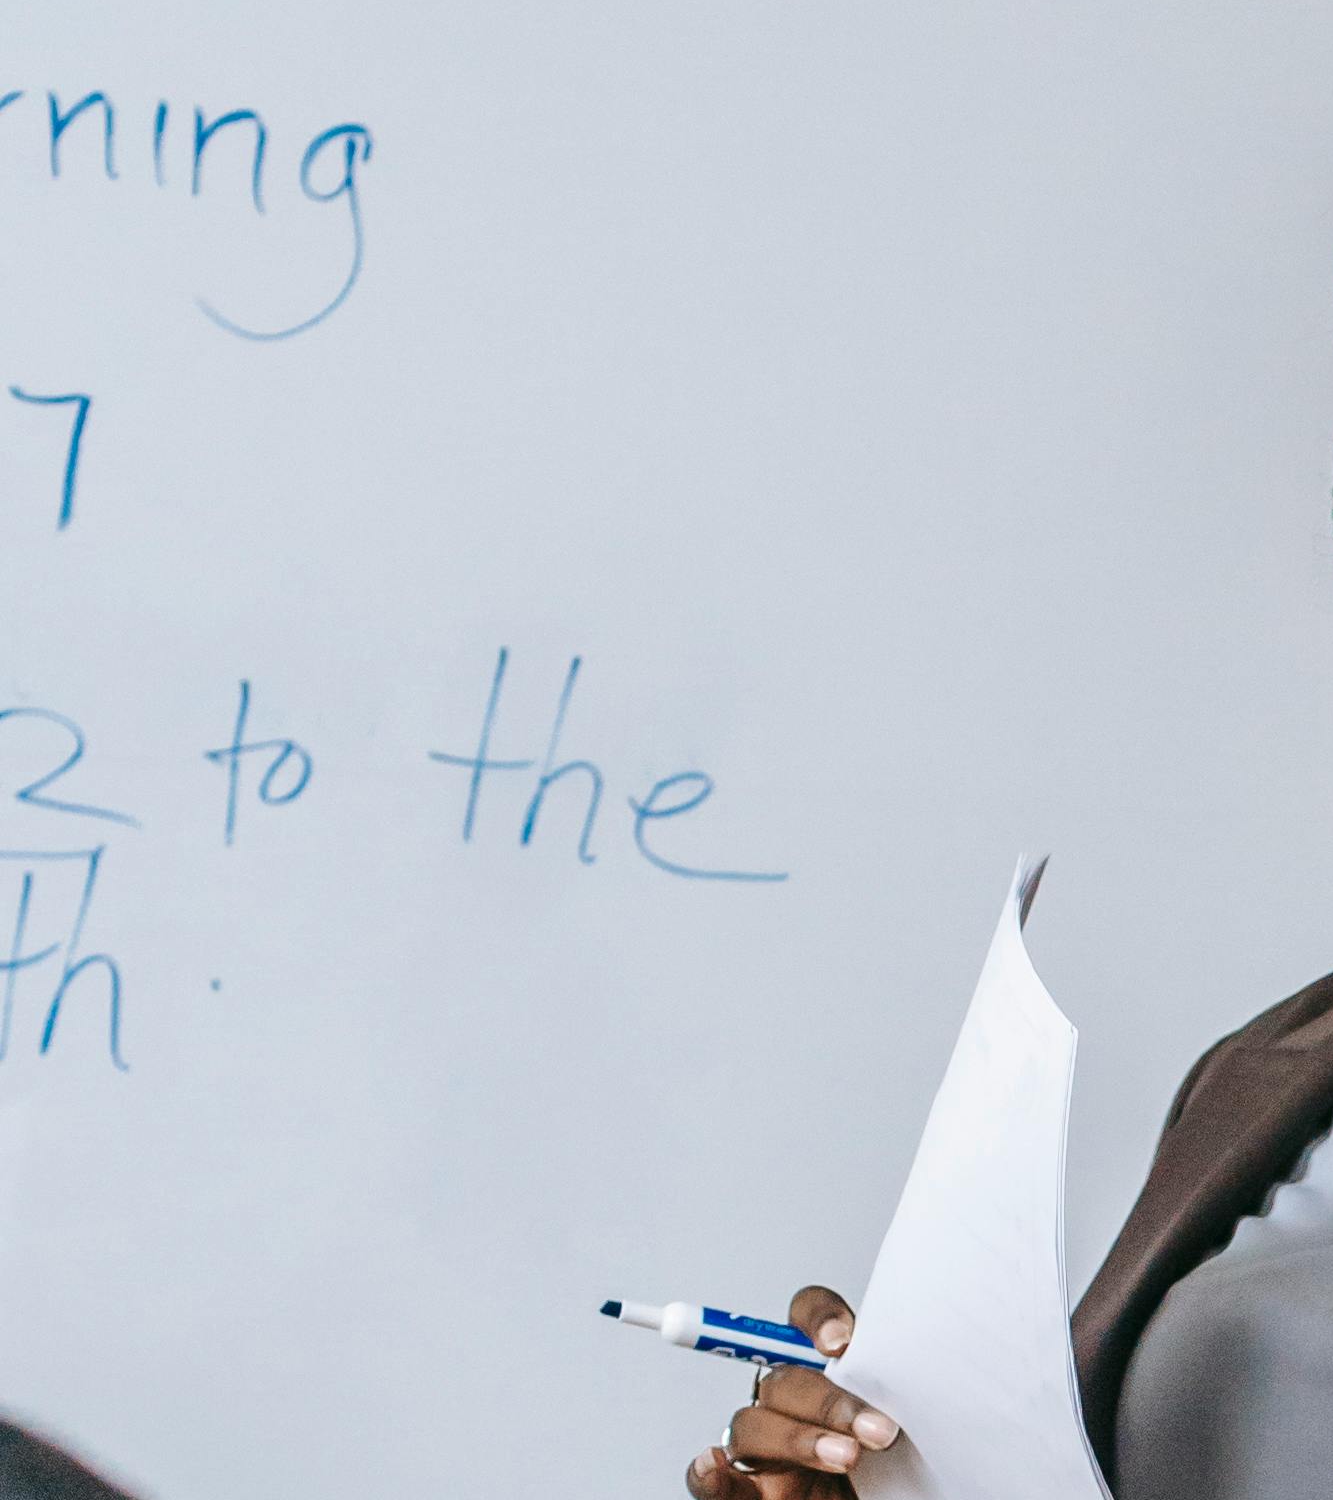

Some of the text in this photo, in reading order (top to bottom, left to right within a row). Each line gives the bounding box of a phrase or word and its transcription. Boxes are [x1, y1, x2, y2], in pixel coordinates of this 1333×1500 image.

[8, 384, 94, 533] 7
[203, 678, 315, 846] to
[428, 646, 790, 884] the
